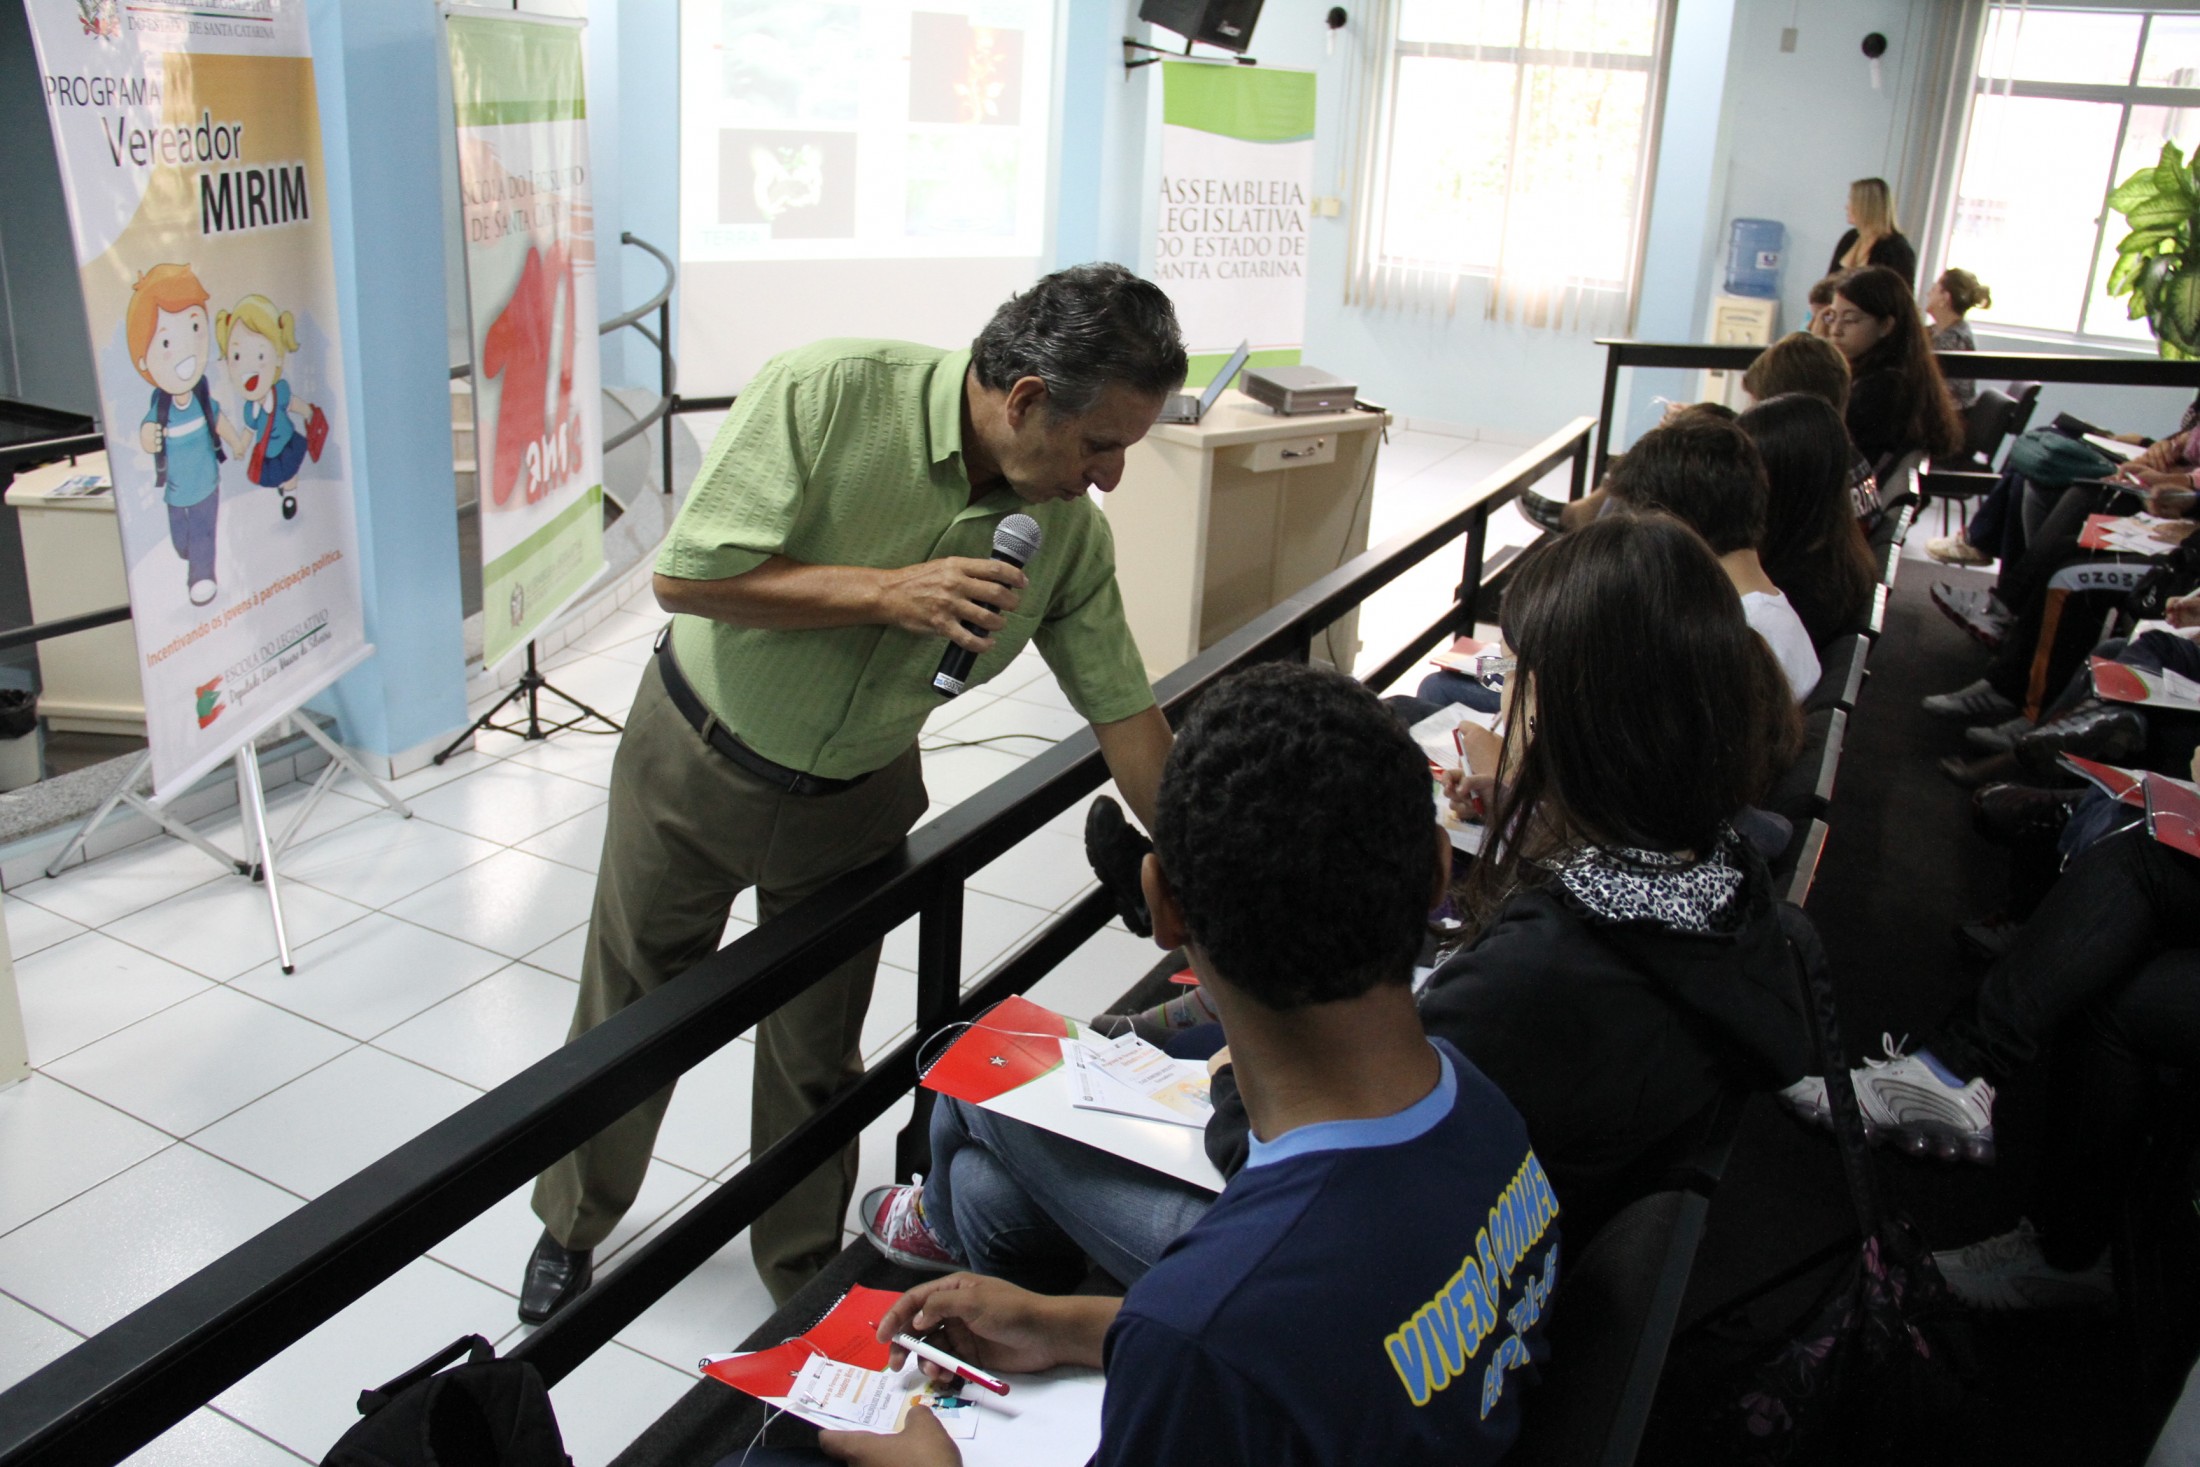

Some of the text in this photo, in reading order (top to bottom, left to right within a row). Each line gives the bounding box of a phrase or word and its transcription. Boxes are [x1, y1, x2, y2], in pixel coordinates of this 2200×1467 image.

[203, 22, 232, 36] SANTA
[233, 24, 275, 39] CATARINA
[46, 75, 162, 106] PROGRAMA
[102, 110, 242, 167] Vereador
[200, 166, 309, 234] MIRIM
[462, 178, 505, 206] SCOLA
[1161, 175, 1305, 205] ASSEMBLEIA
[472, 216, 489, 242] DE
[1193, 236, 1272, 258] ESTADO
[1278, 236, 1305, 257] DE
[1217, 260, 1302, 280] CATARINA
[146, 623, 211, 669] Incentivando
[211, 616, 223, 631] os
[222, 597, 253, 628] jovens
[260, 563, 312, 606] participação
[224, 608, 329, 683] ESCOLA DO LEGISLATIVO
[1384, 1255, 1498, 1407] VIVER
